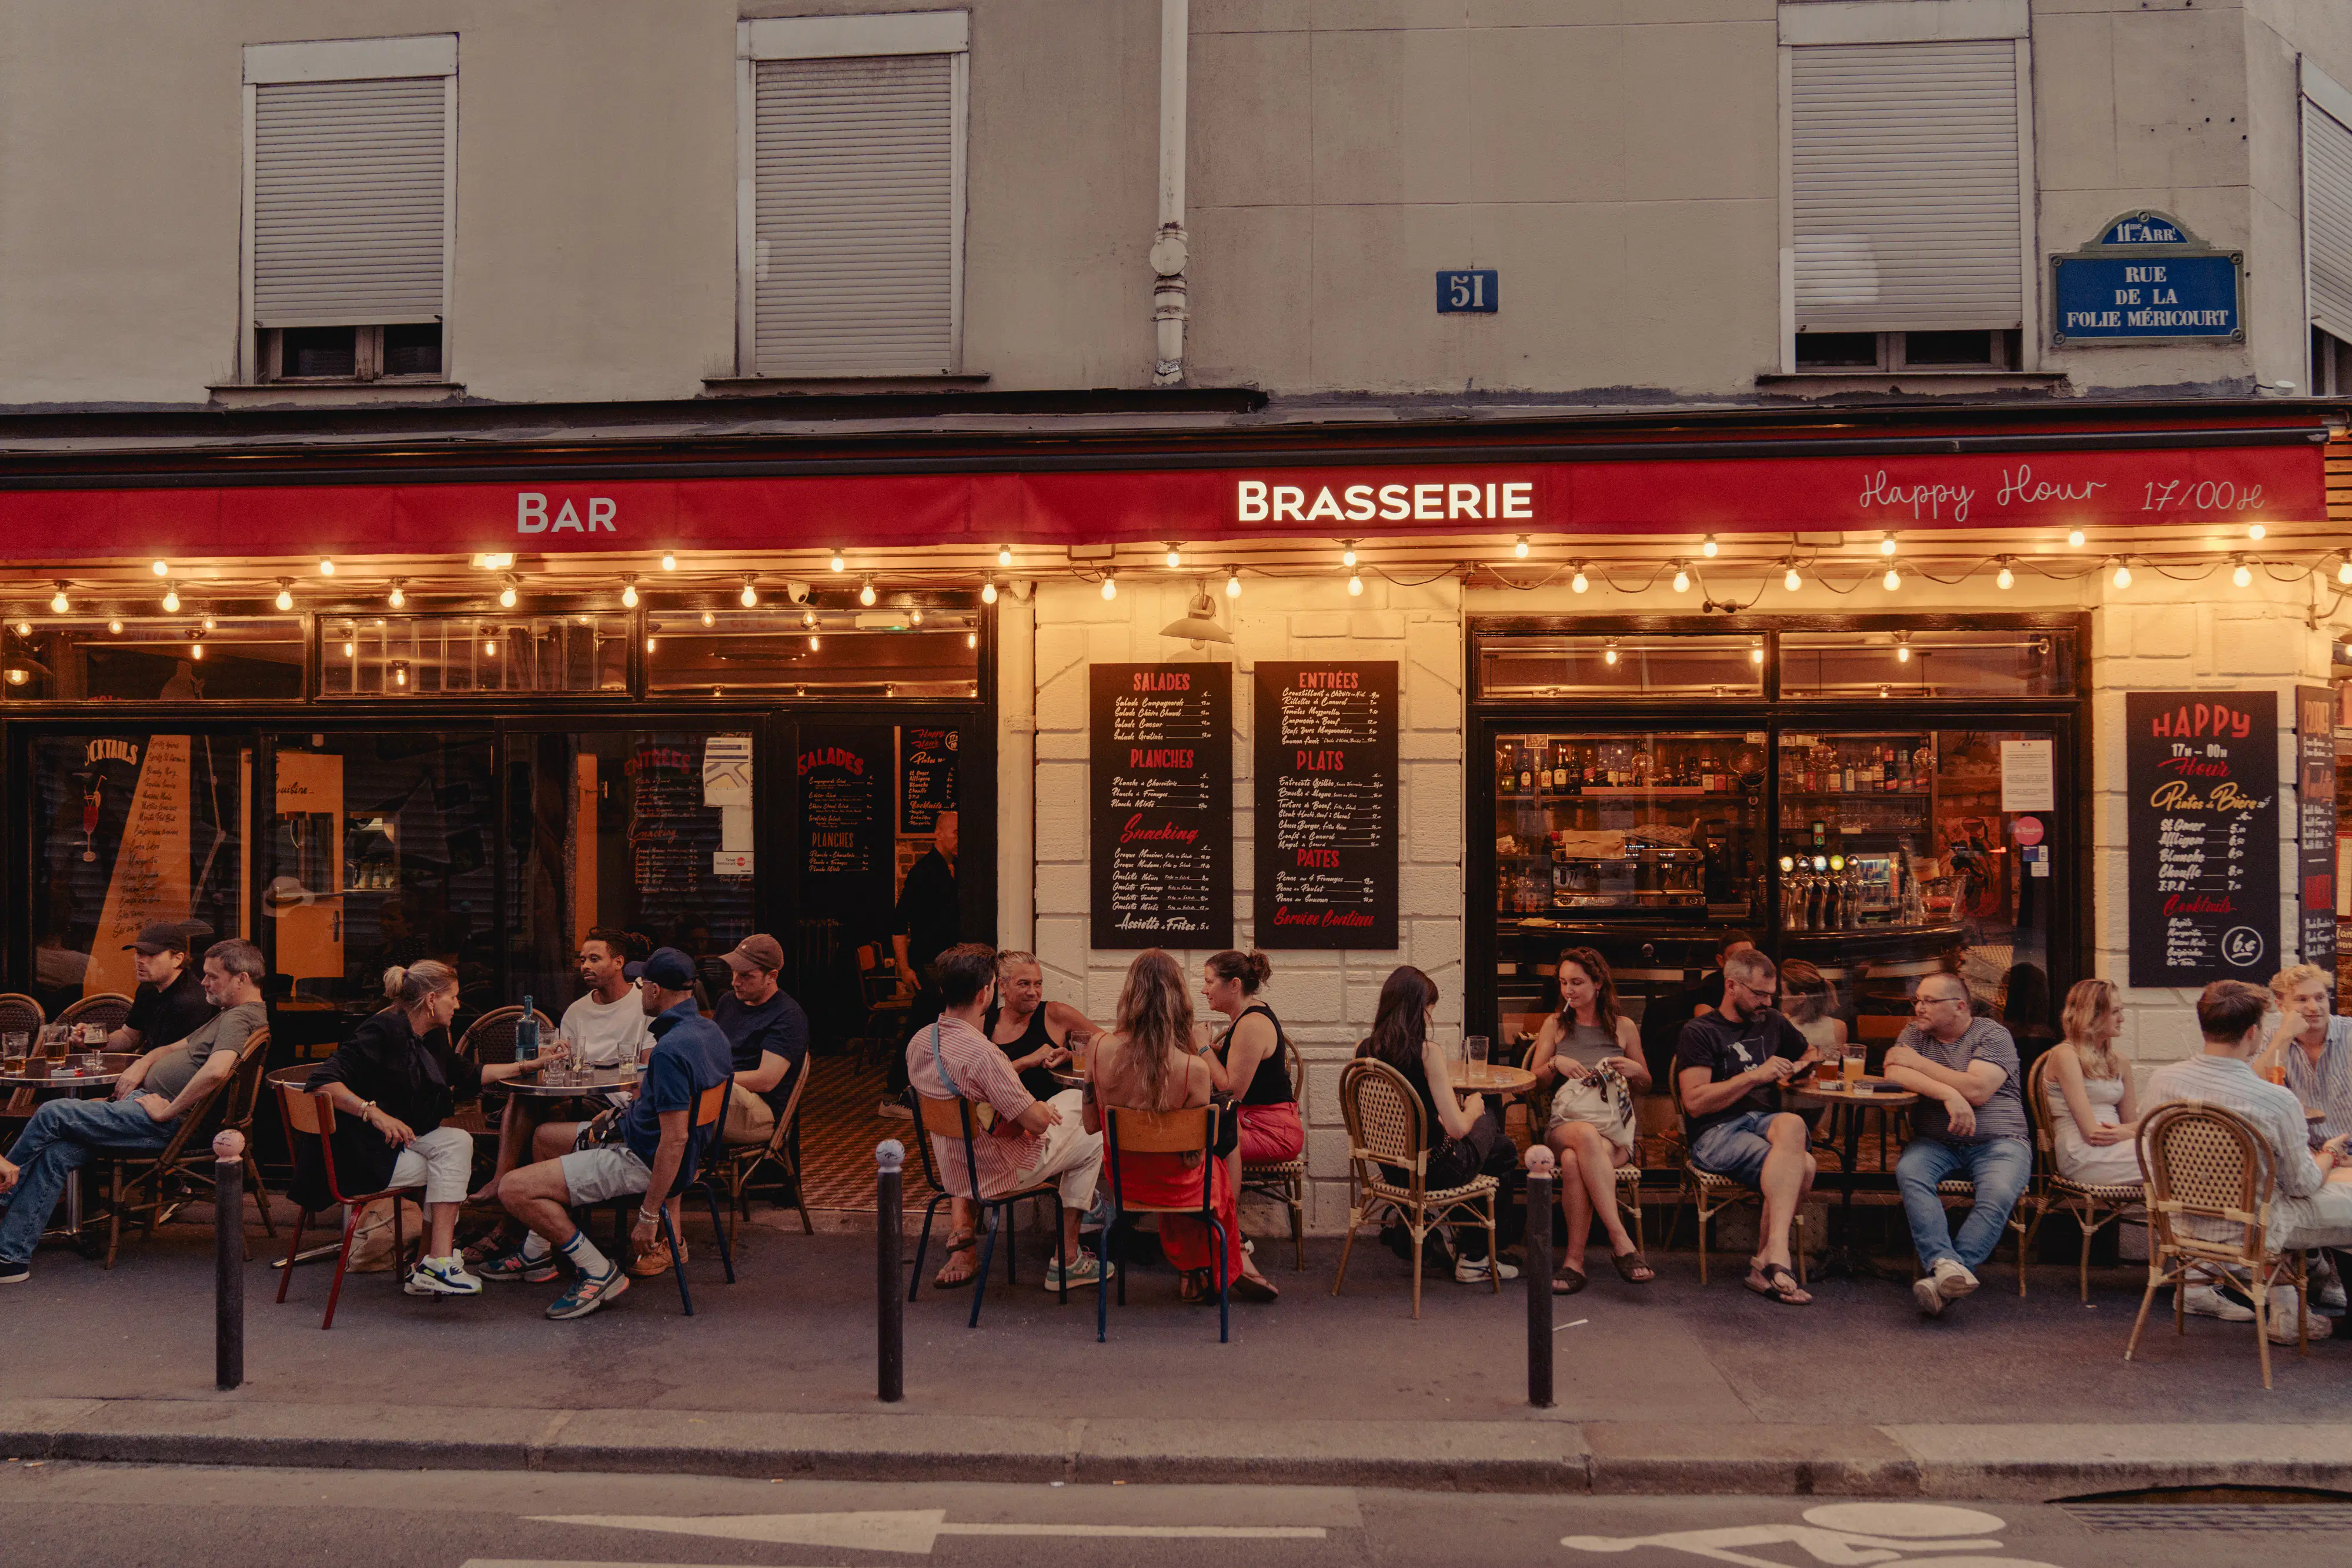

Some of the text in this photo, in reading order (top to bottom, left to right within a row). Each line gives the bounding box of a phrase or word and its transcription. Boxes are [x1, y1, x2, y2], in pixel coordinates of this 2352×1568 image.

[2125, 266, 2167, 283] RUE
[1451, 275, 1484, 306] 51
[2115, 288, 2179, 305] DE LA
[2066, 307, 2229, 327] FOLIE MÉRICOURT
[1859, 470, 1975, 522] Happy
[1997, 464, 2107, 506] Hour
[1238, 480, 1533, 521] BRASSERIE
[517, 492, 617, 533] BAR
[1133, 672, 1191, 692] SALADES
[1298, 670, 1359, 689] ENTRÉES
[1282, 687, 1325, 697] Croustillant
[1115, 696, 1184, 708] Salade Campagnarde
[1281, 696, 1311, 706] Rillettes
[1321, 696, 1348, 707] Canard
[1115, 706, 1135, 717] Salade
[1159, 708, 1182, 717] Chaud
[1281, 705, 1305, 715] Tomates
[1308, 706, 1341, 717] Mozzarella
[1114, 717, 1163, 728] Salade Caesar
[1282, 715, 1315, 726] Carpaccio
[2152, 702, 2251, 738] HAPPY
[910, 728, 946, 739] Happy
[1114, 728, 1164, 741] Salade Gratinée
[1300, 726, 1315, 735] Durs
[1317, 726, 1353, 735] Mayonnaise
[1281, 735, 1302, 745] Saumon
[85, 738, 139, 767] CKTAILS
[1130, 748, 1195, 769] PLANCHES
[797, 746, 864, 776] SALADES
[1296, 750, 1344, 771] PLATS
[2157, 757, 2232, 778] Hour
[1112, 776, 1178, 788] Planche Charcuterie
[1279, 775, 1312, 787] Entrecôte
[1111, 786, 1168, 800] Planche Fromages
[1278, 787, 1304, 798] Bavette
[2150, 780, 2204, 812] Pintes
[2209, 781, 2258, 812] Bière
[1110, 798, 1155, 808] Planche Mixte
[1277, 798, 1302, 808] Tartare
[1278, 808, 1296, 818] Steak
[1120, 812, 1200, 845] Snacking
[1278, 819, 1297, 829] Cheese
[812, 832, 854, 848] PLANCHES
[1278, 830, 1336, 841] Confit Canard
[1278, 840, 1299, 850] Magret
[1114, 847, 1136, 860] Croque
[1297, 848, 1340, 868] PATES
[2158, 848, 2206, 863] Blanche
[1113, 858, 1134, 869] Croque
[1112, 870, 1159, 881] Omelette Nature
[1276, 871, 1297, 882] Penne
[1316, 874, 1344, 884] Fromages
[2158, 862, 2202, 881] Chouffe
[1112, 881, 1164, 893] Omelette Fromage
[1276, 882, 1292, 892] Penne
[1300, 883, 1326, 892] Poulet
[1112, 891, 1158, 902] Omelette Jambon
[1275, 893, 1293, 902] Penne
[1304, 894, 1329, 903] Saumon
[1112, 901, 1160, 912] Omelette Mixte
[2163, 893, 2239, 917] Cocktails
[1114, 912, 1160, 930] Assiette
[1273, 905, 1375, 928] Service Continu
